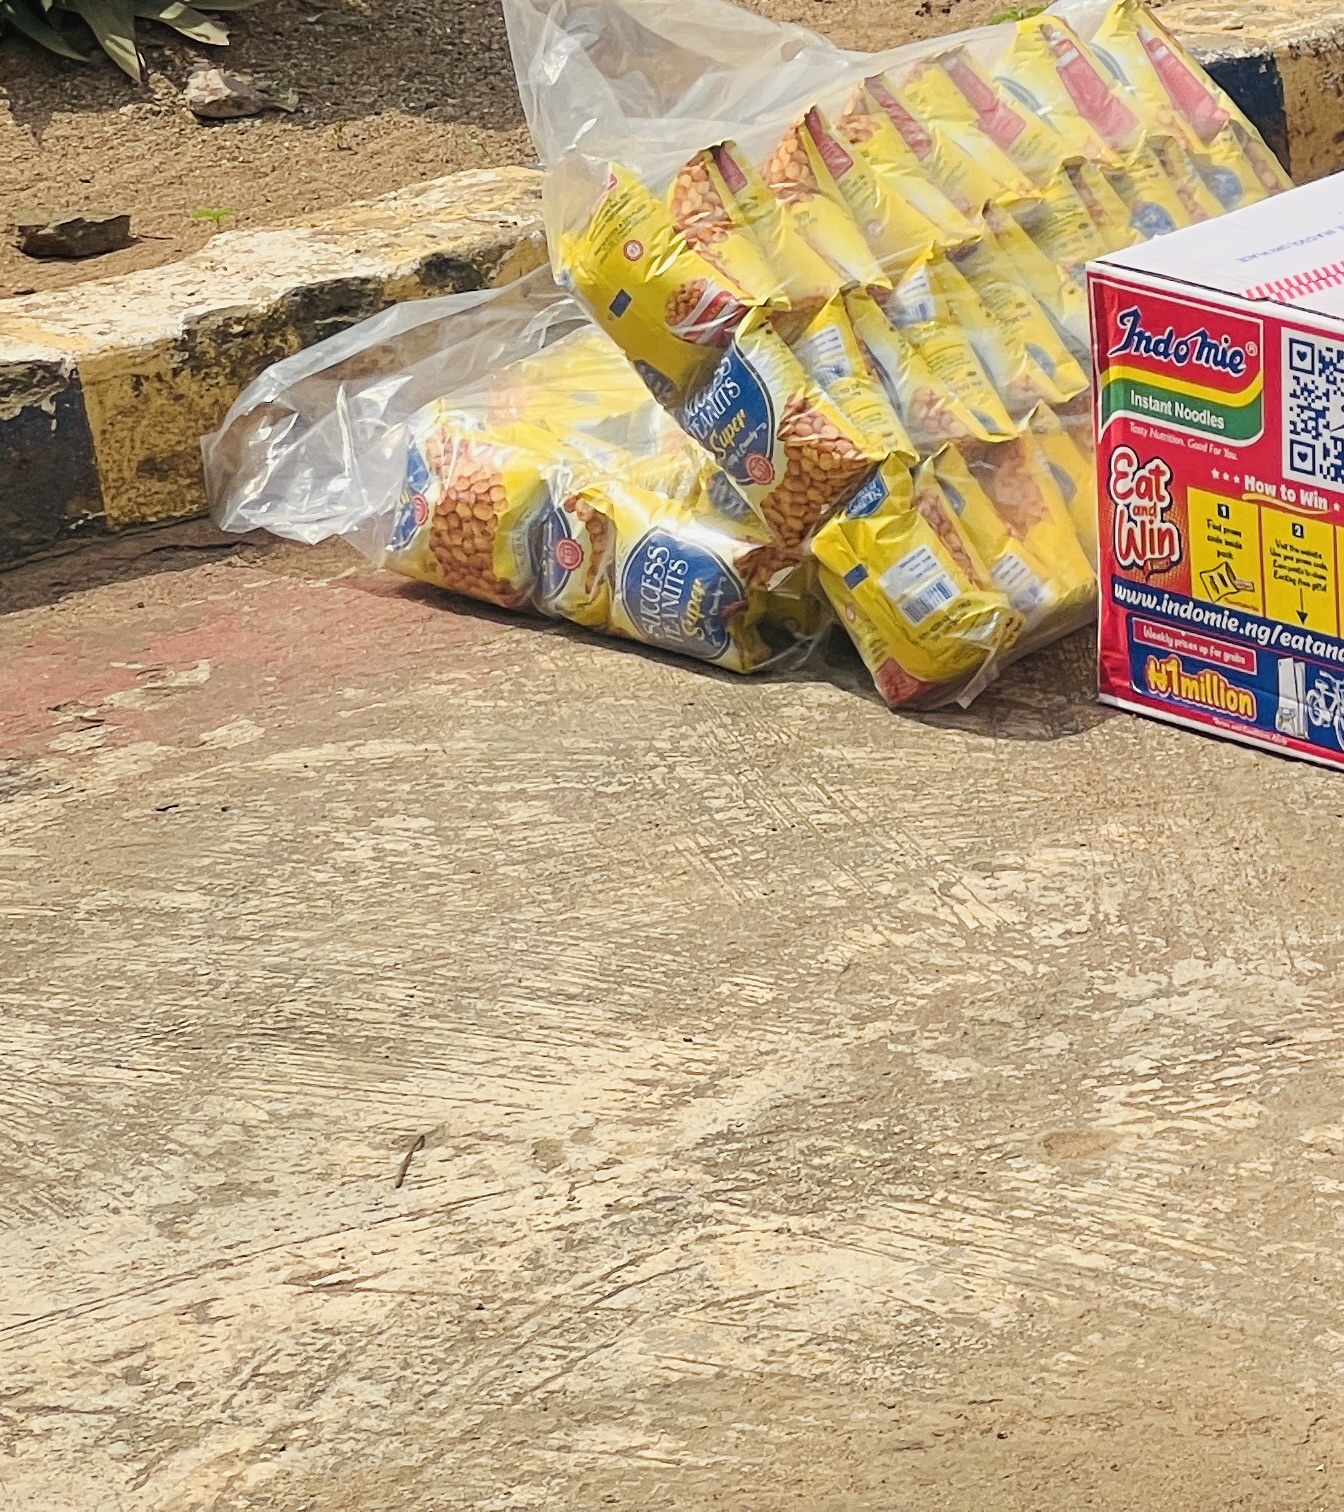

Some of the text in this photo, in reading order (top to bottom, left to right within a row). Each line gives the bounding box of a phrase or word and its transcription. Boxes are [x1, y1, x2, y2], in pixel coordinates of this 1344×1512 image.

[1130, 389, 1226, 430] Instant Noodles
[708, 408, 747, 462] Super
[1129, 422, 1149, 438] Tasty
[1187, 437, 1209, 454] Good
[1209, 444, 1223, 457] For
[1112, 450, 1167, 502] Eat
[1244, 474, 1329, 511] How to Win
[1131, 501, 1158, 521] and
[1117, 508, 1176, 562] Win
[640, 545, 671, 640] SUCCESS
[680, 577, 706, 641] Super
[1143, 624, 1174, 648] Weekly
